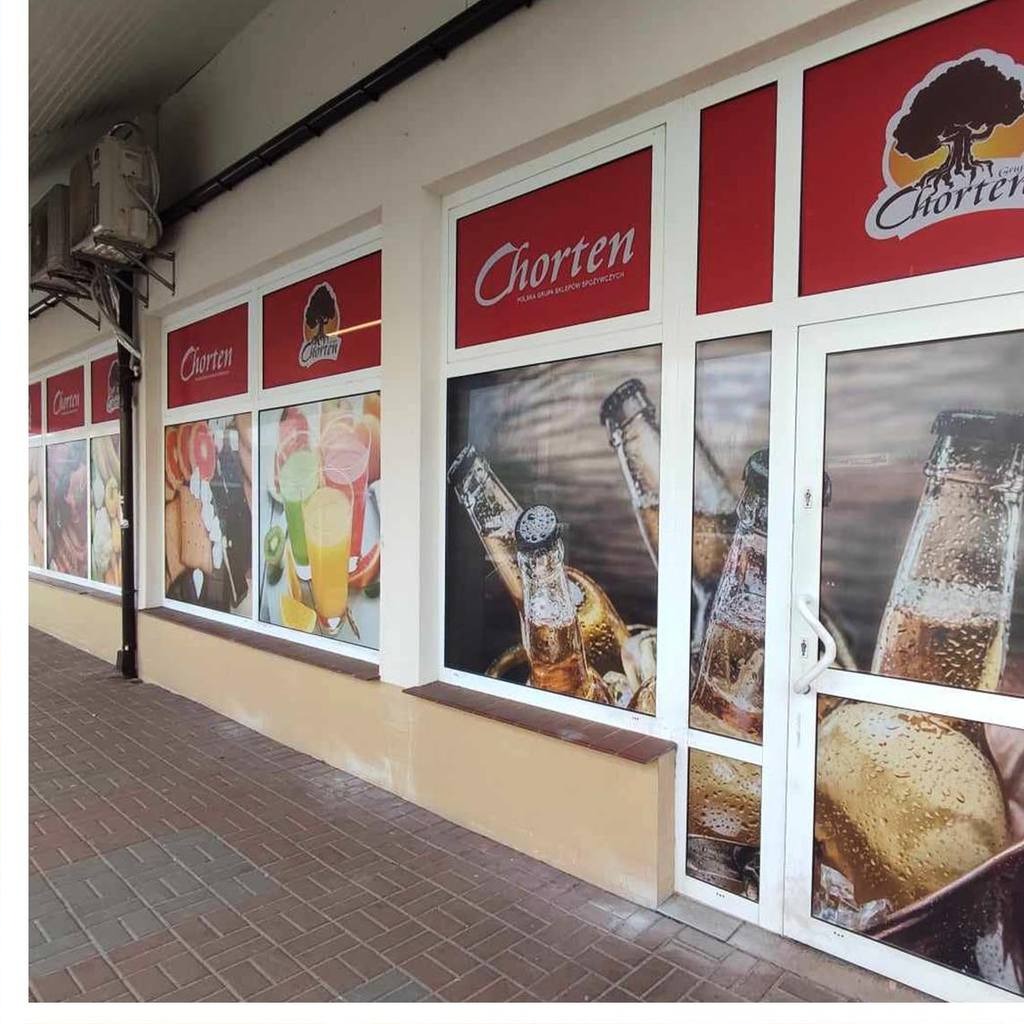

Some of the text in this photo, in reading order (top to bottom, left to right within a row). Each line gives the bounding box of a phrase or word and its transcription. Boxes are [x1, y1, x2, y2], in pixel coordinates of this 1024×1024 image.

[475, 227, 635, 306] Chorten
[181, 346, 233, 382] Chorten
[302, 341, 338, 362] Chorten
[53, 390, 80, 416] Chorten
